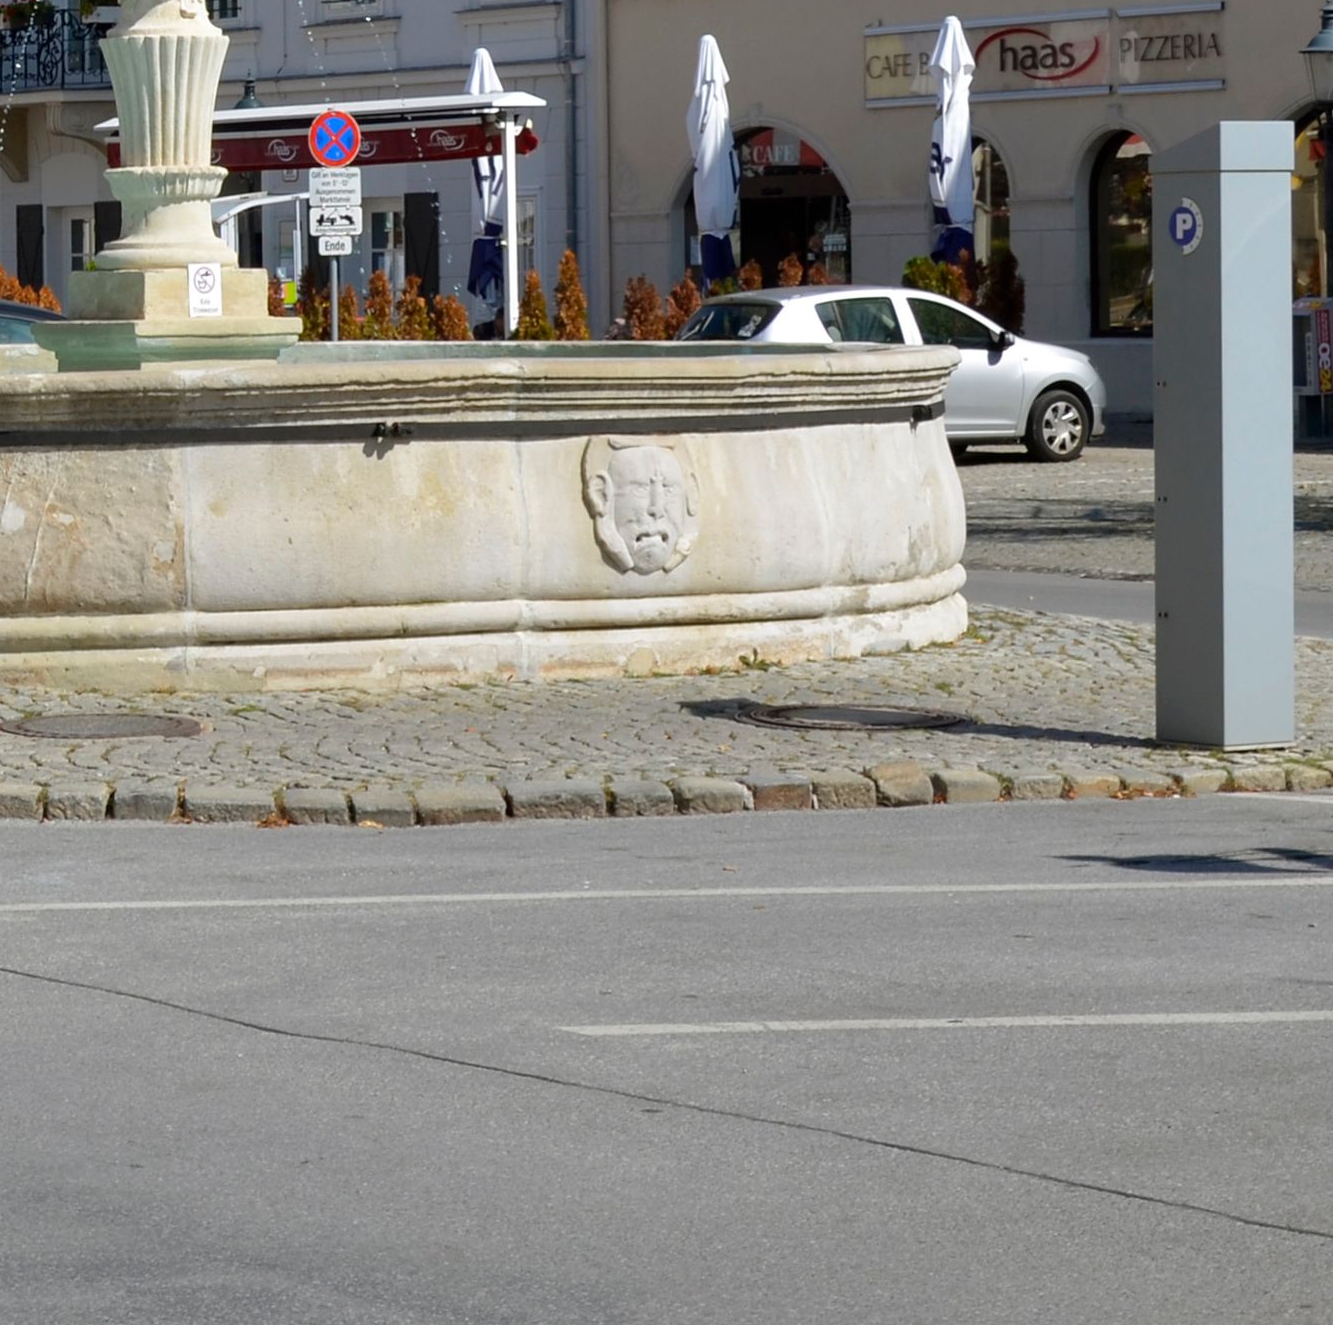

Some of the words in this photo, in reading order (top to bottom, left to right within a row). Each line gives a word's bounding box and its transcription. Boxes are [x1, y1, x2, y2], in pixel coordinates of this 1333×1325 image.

[866, 53, 912, 79] CAFE
[999, 38, 1076, 72] haas
[1119, 33, 1222, 63] PIZZERIA
[752, 144, 794, 163] CAFE
[1176, 213, 1193, 240] P
[325, 240, 346, 252] Ende
